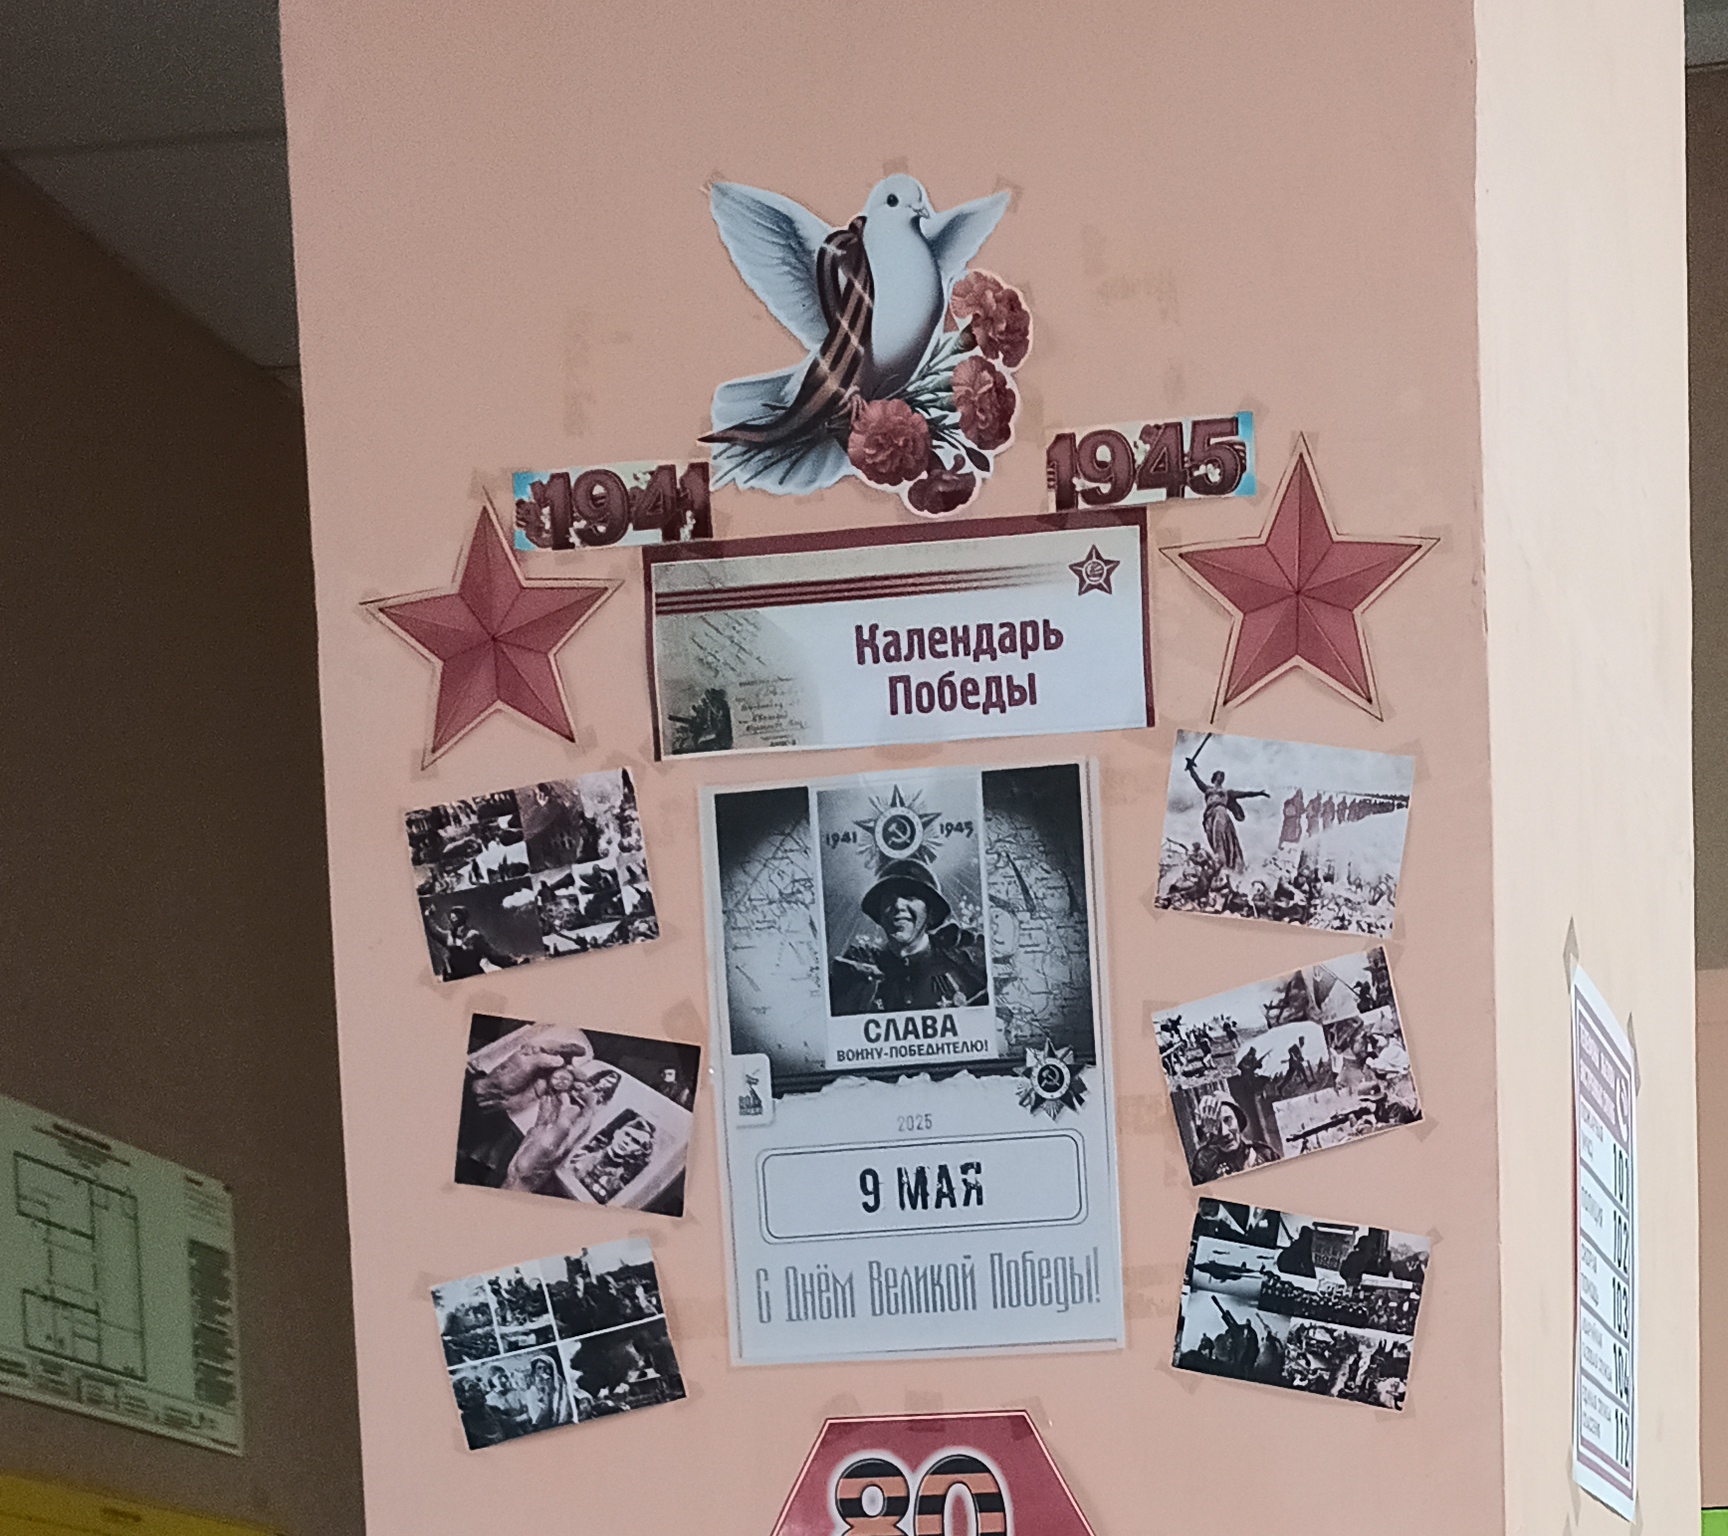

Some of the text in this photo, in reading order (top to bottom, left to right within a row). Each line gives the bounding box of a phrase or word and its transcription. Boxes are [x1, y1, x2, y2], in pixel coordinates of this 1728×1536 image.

[1048, 415, 1245, 511] 1945
[533, 462, 712, 549] 1941
[854, 613, 1064, 666] Календарь
[889, 672, 1038, 717] Победы
[826, 830, 858, 847] 1941
[939, 820, 974, 839] 1945
[836, 1038, 990, 1063] ВОИНУ-ПОБЕДИТЕЛЮ!
[863, 1013, 959, 1044] СЛАВА
[897, 1113, 933, 1132] 2025
[859, 1161, 985, 1213] 9 МАЯ
[1612, 1143, 1630, 1209] 101
[1612, 1210, 1629, 1275] 102
[756, 1246, 1101, 1324] С Днём Великой Победы!
[1612, 1276, 1629, 1339] 103
[1614, 1408, 1630, 1468] 112
